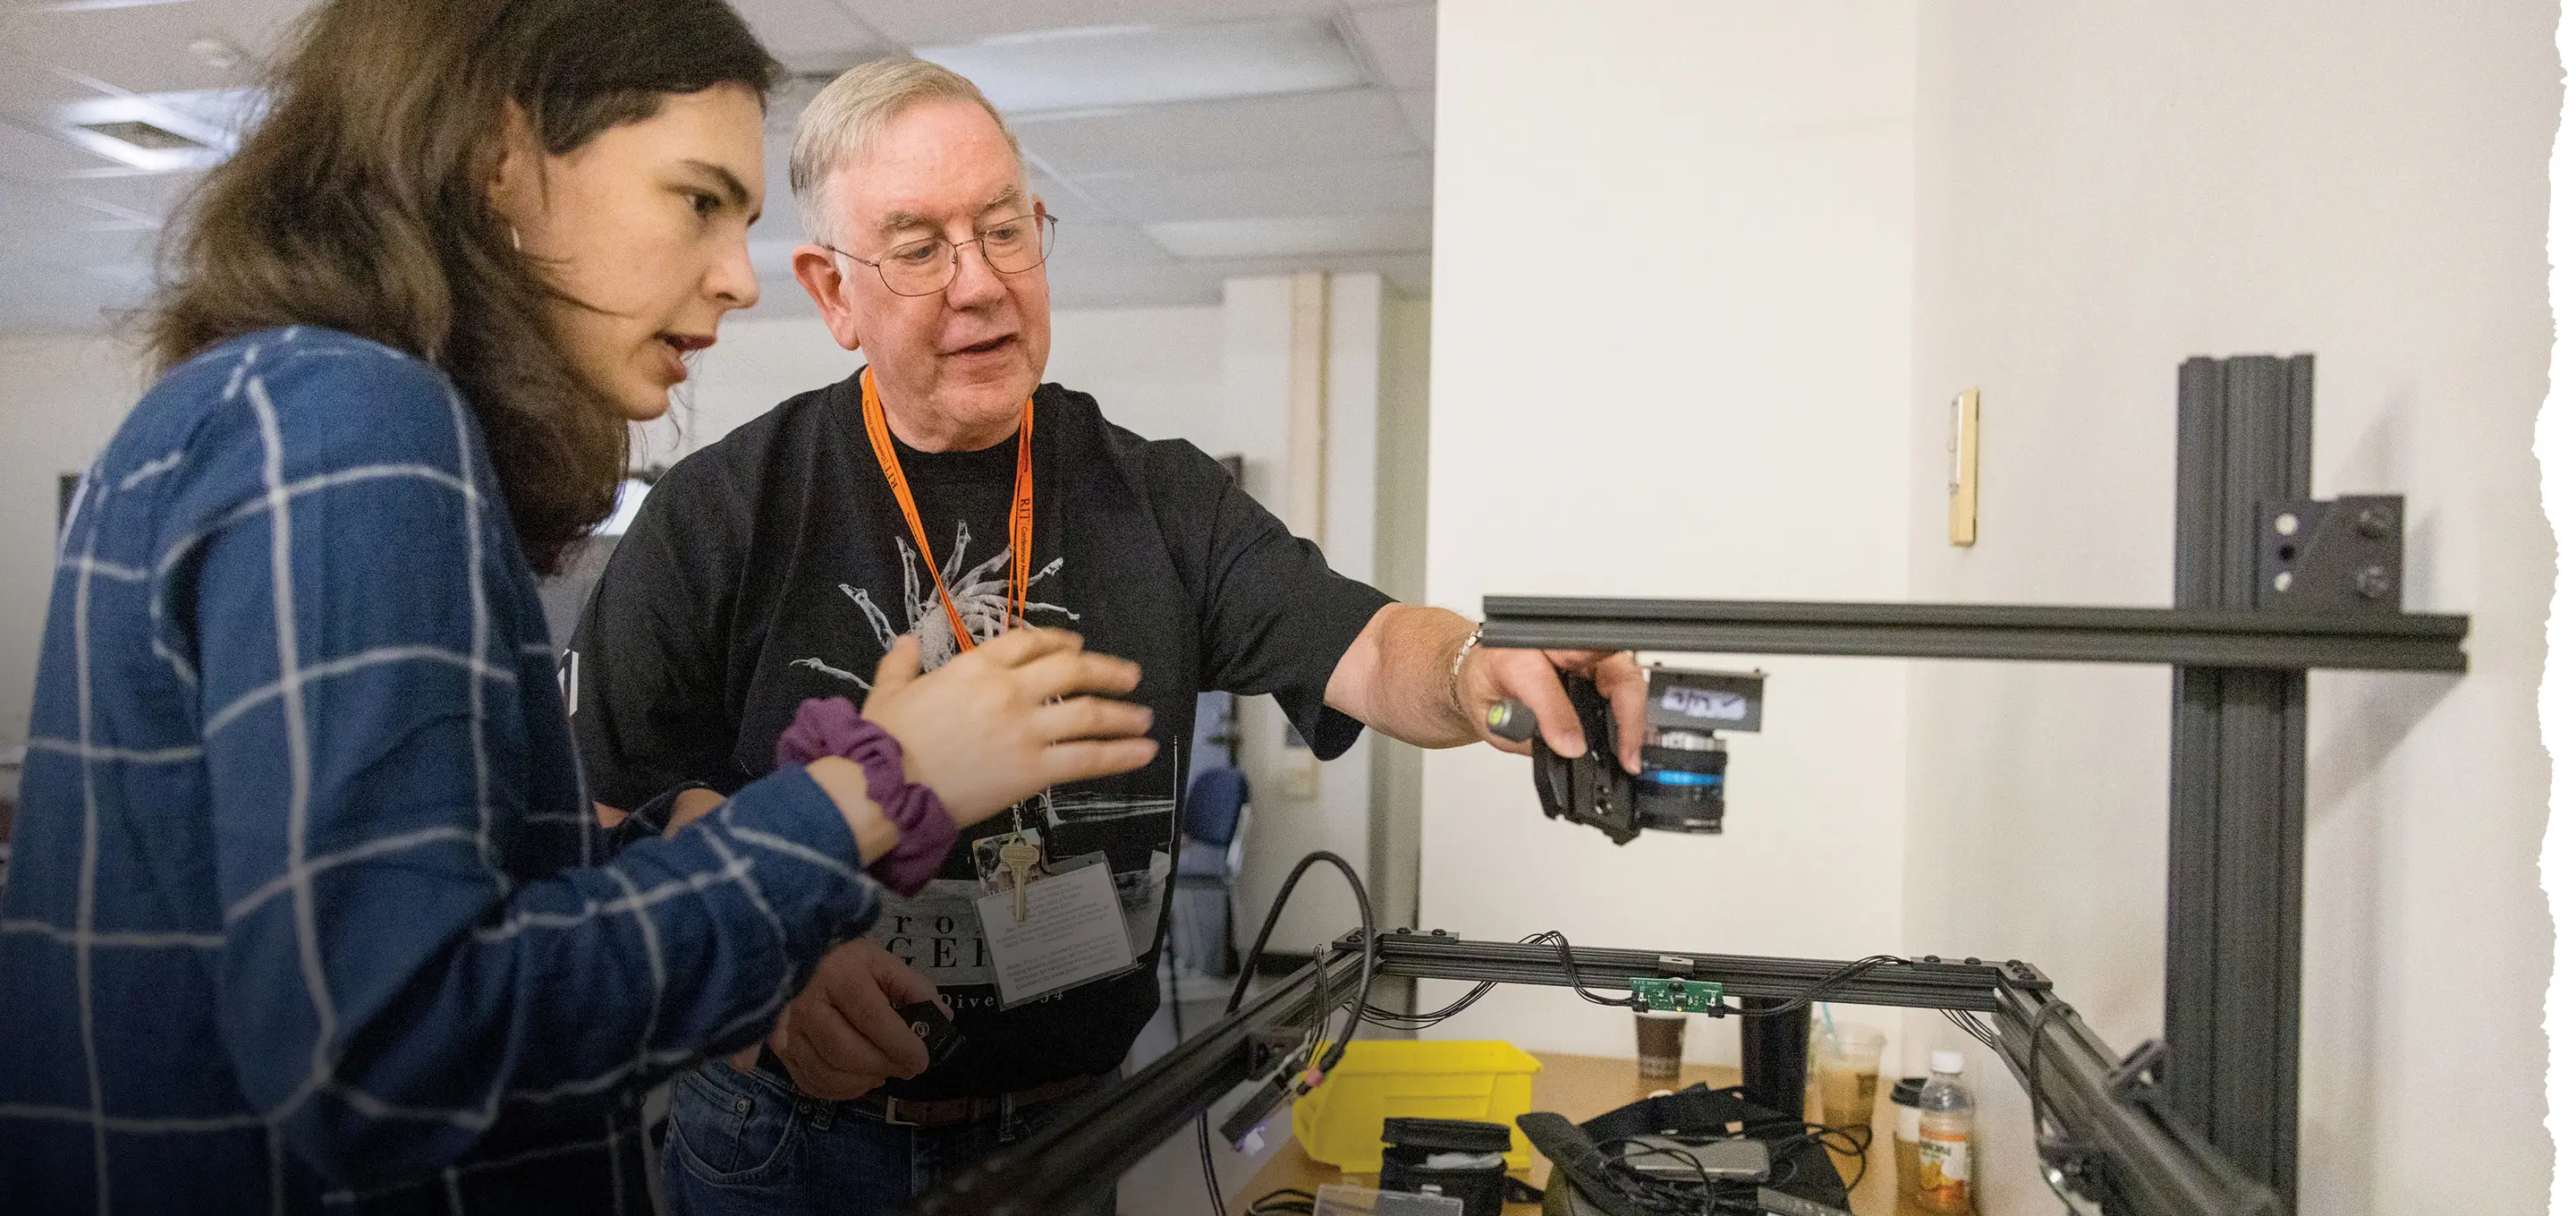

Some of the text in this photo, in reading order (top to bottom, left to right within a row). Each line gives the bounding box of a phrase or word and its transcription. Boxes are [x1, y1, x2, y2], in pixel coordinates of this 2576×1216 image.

[886, 466, 898, 489] RIT
[1020, 497, 1030, 523] RIT
[1021, 526, 1029, 565] Conference
